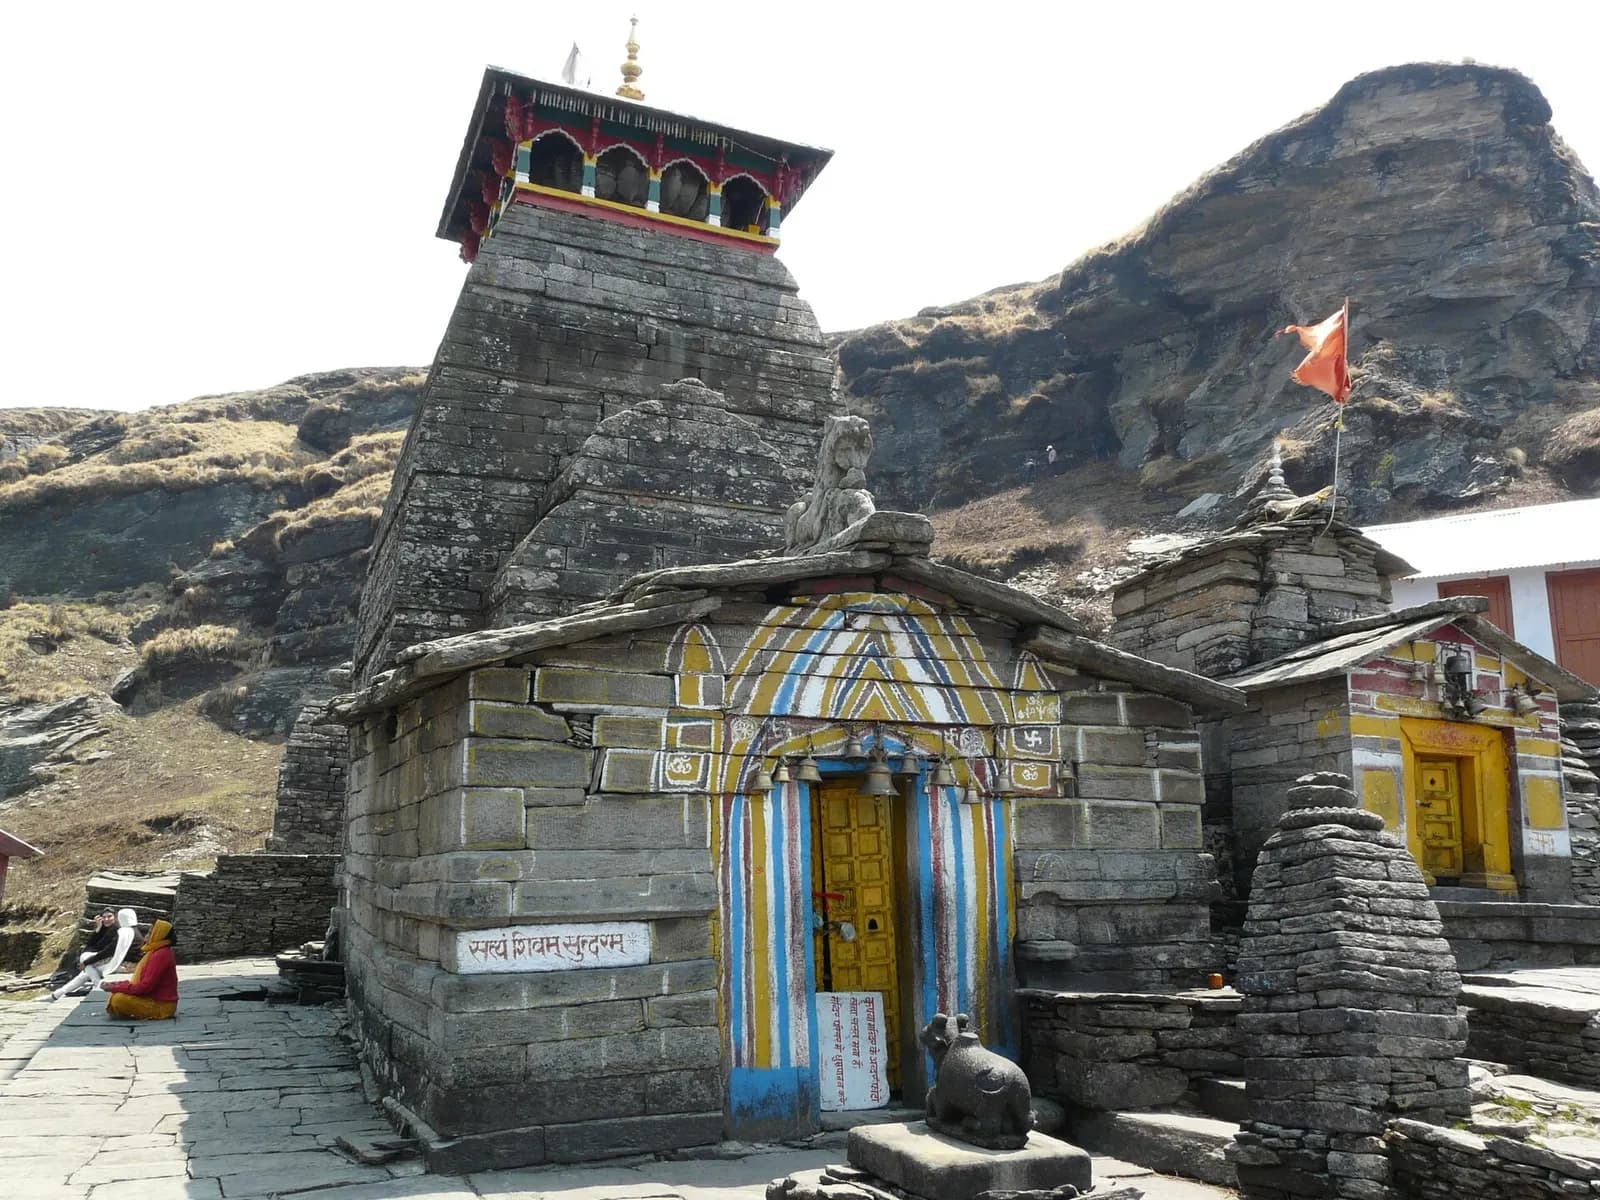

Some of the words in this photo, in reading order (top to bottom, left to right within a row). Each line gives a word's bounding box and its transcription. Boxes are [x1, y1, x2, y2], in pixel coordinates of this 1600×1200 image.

[669, 755, 692, 774] ॐ
[1022, 765, 1039, 781] ॐ
[469, 933, 508, 963] सत्यं
[512, 931, 560, 960] शिवम्
[562, 933, 625, 963] सुन्दरम्
[869, 1046, 881, 1055] के
